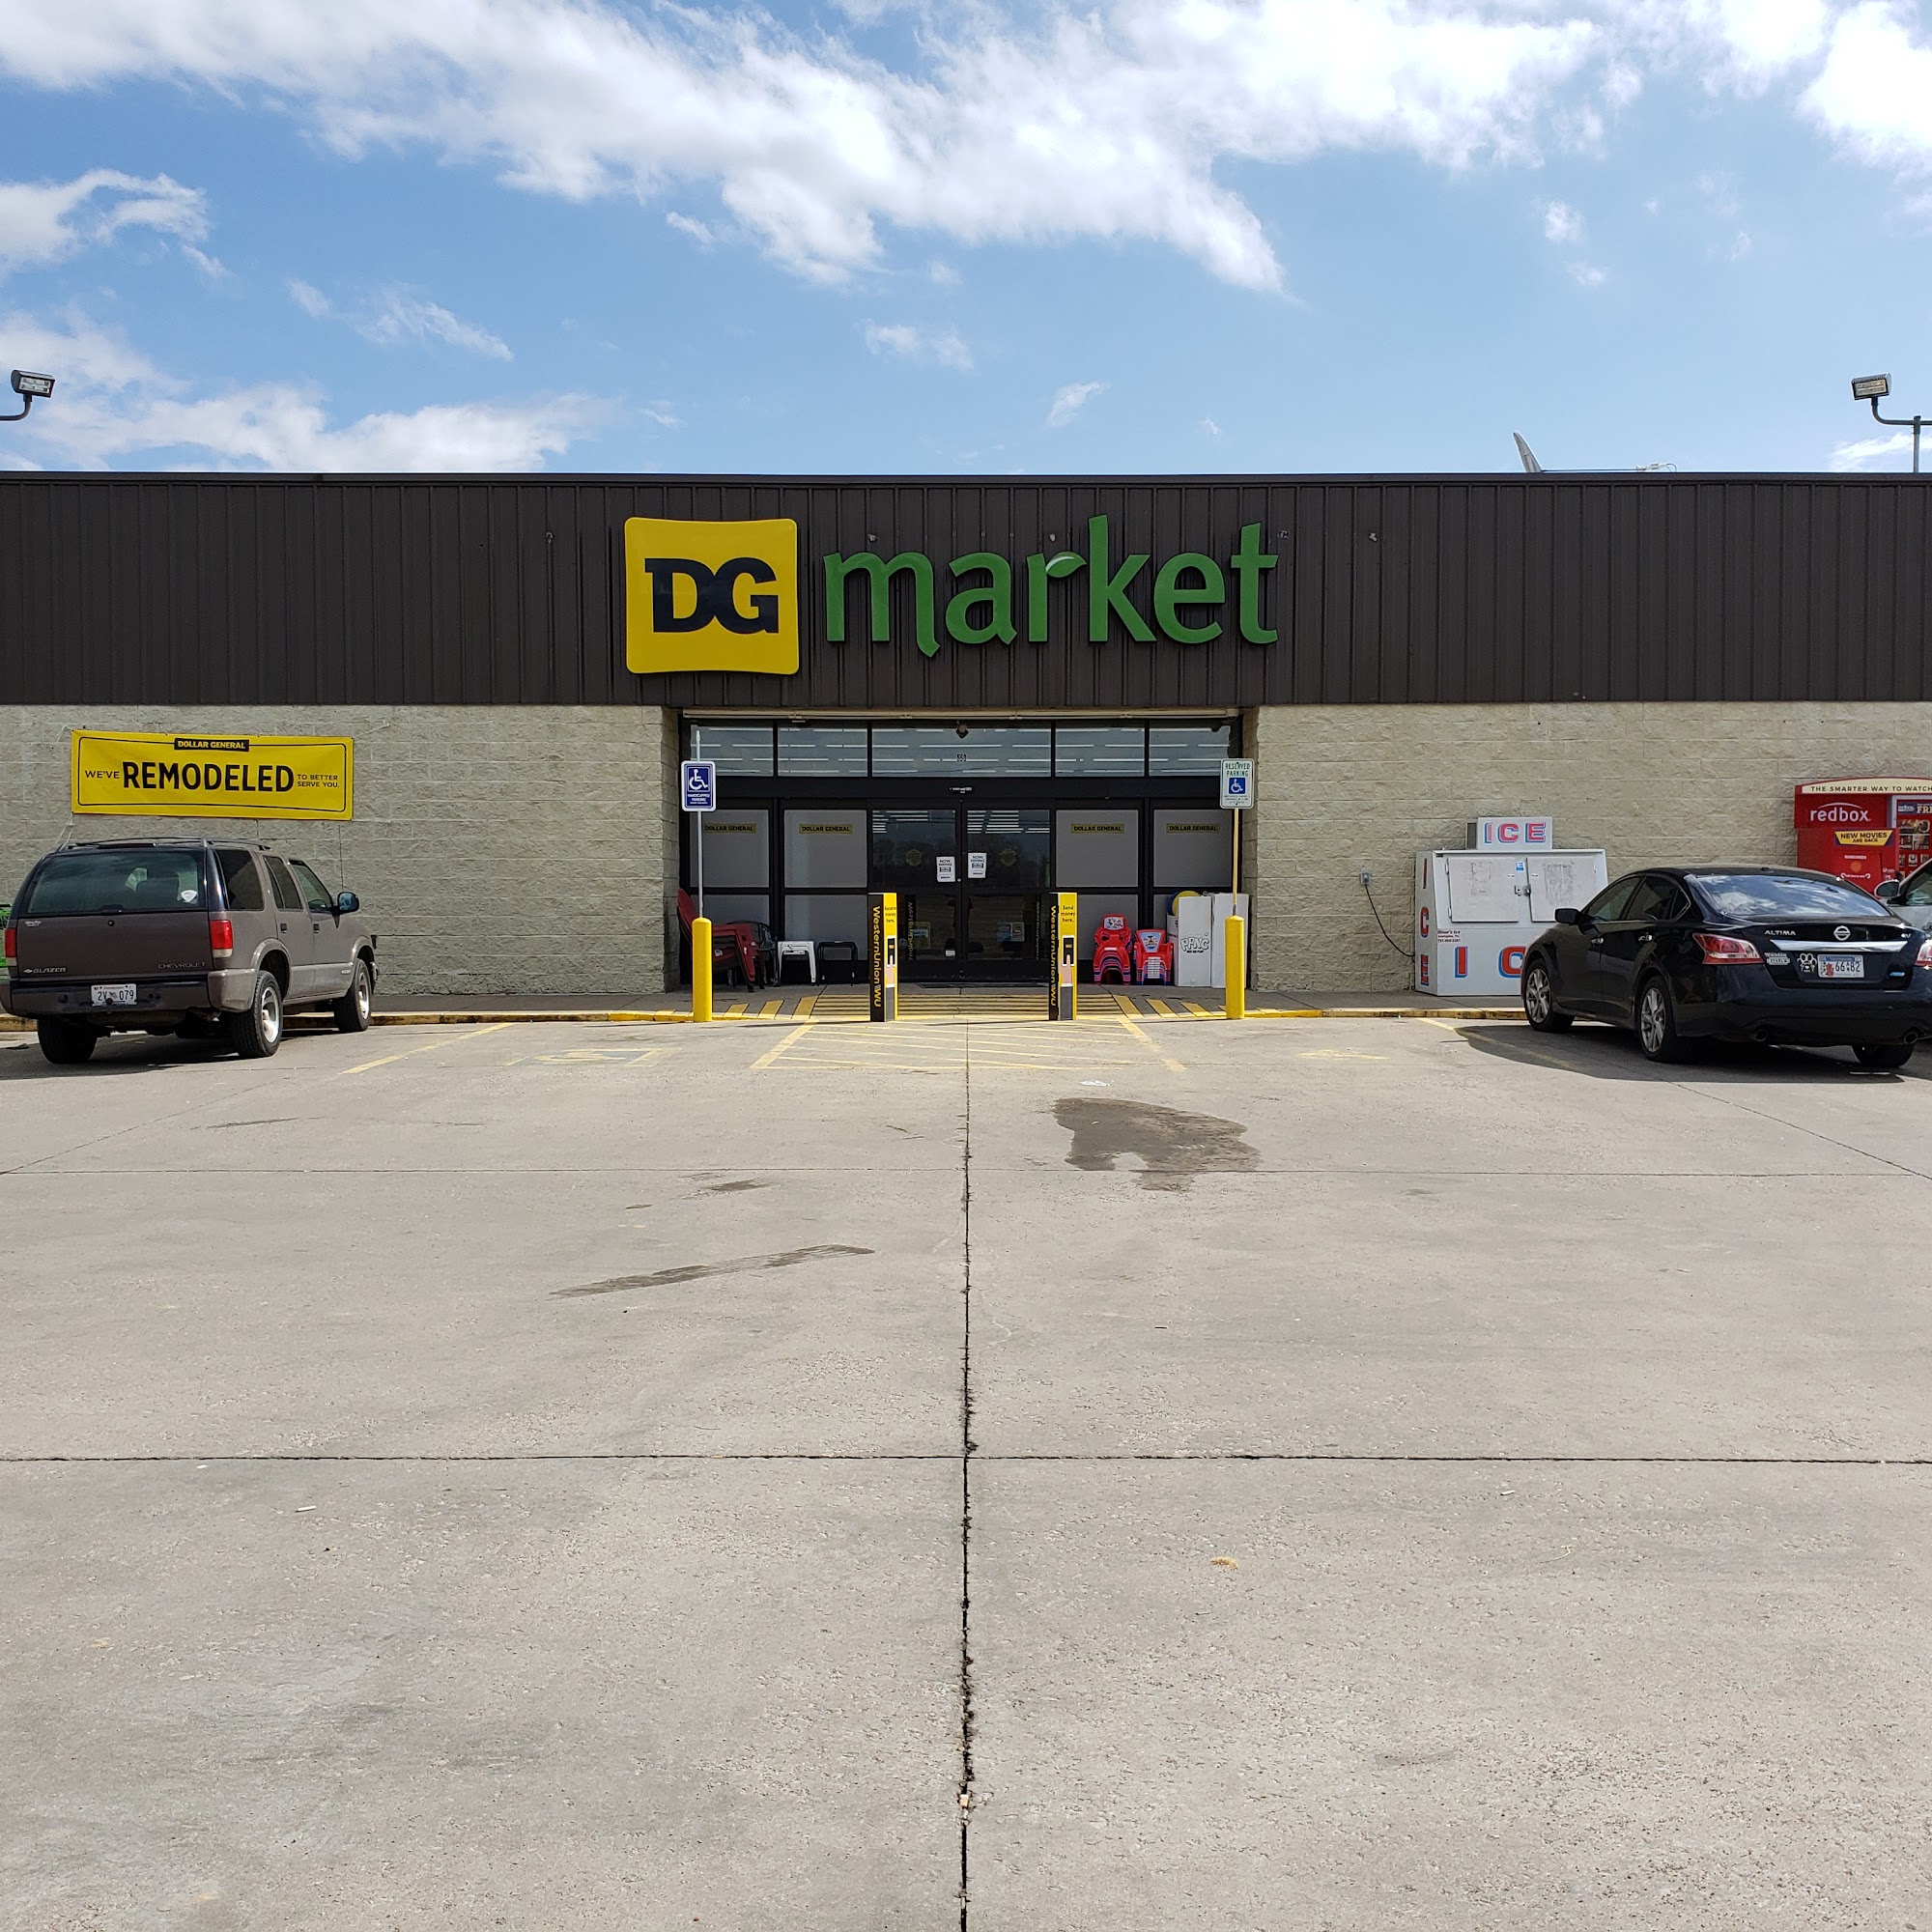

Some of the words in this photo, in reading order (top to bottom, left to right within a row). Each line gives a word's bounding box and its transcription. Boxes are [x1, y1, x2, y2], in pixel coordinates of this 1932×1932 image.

[644, 556, 779, 635] DG
[822, 515, 1279, 658] market
[177, 740, 209, 749] DOLLAR
[210, 741, 245, 750] GENERAL
[85, 770, 120, 779] WE'VE
[122, 761, 295, 793] REMODELED
[1809, 807, 1869, 822] redbox
[1484, 822, 1547, 844] ICE
[872, 905, 882, 984] WesternUnion
